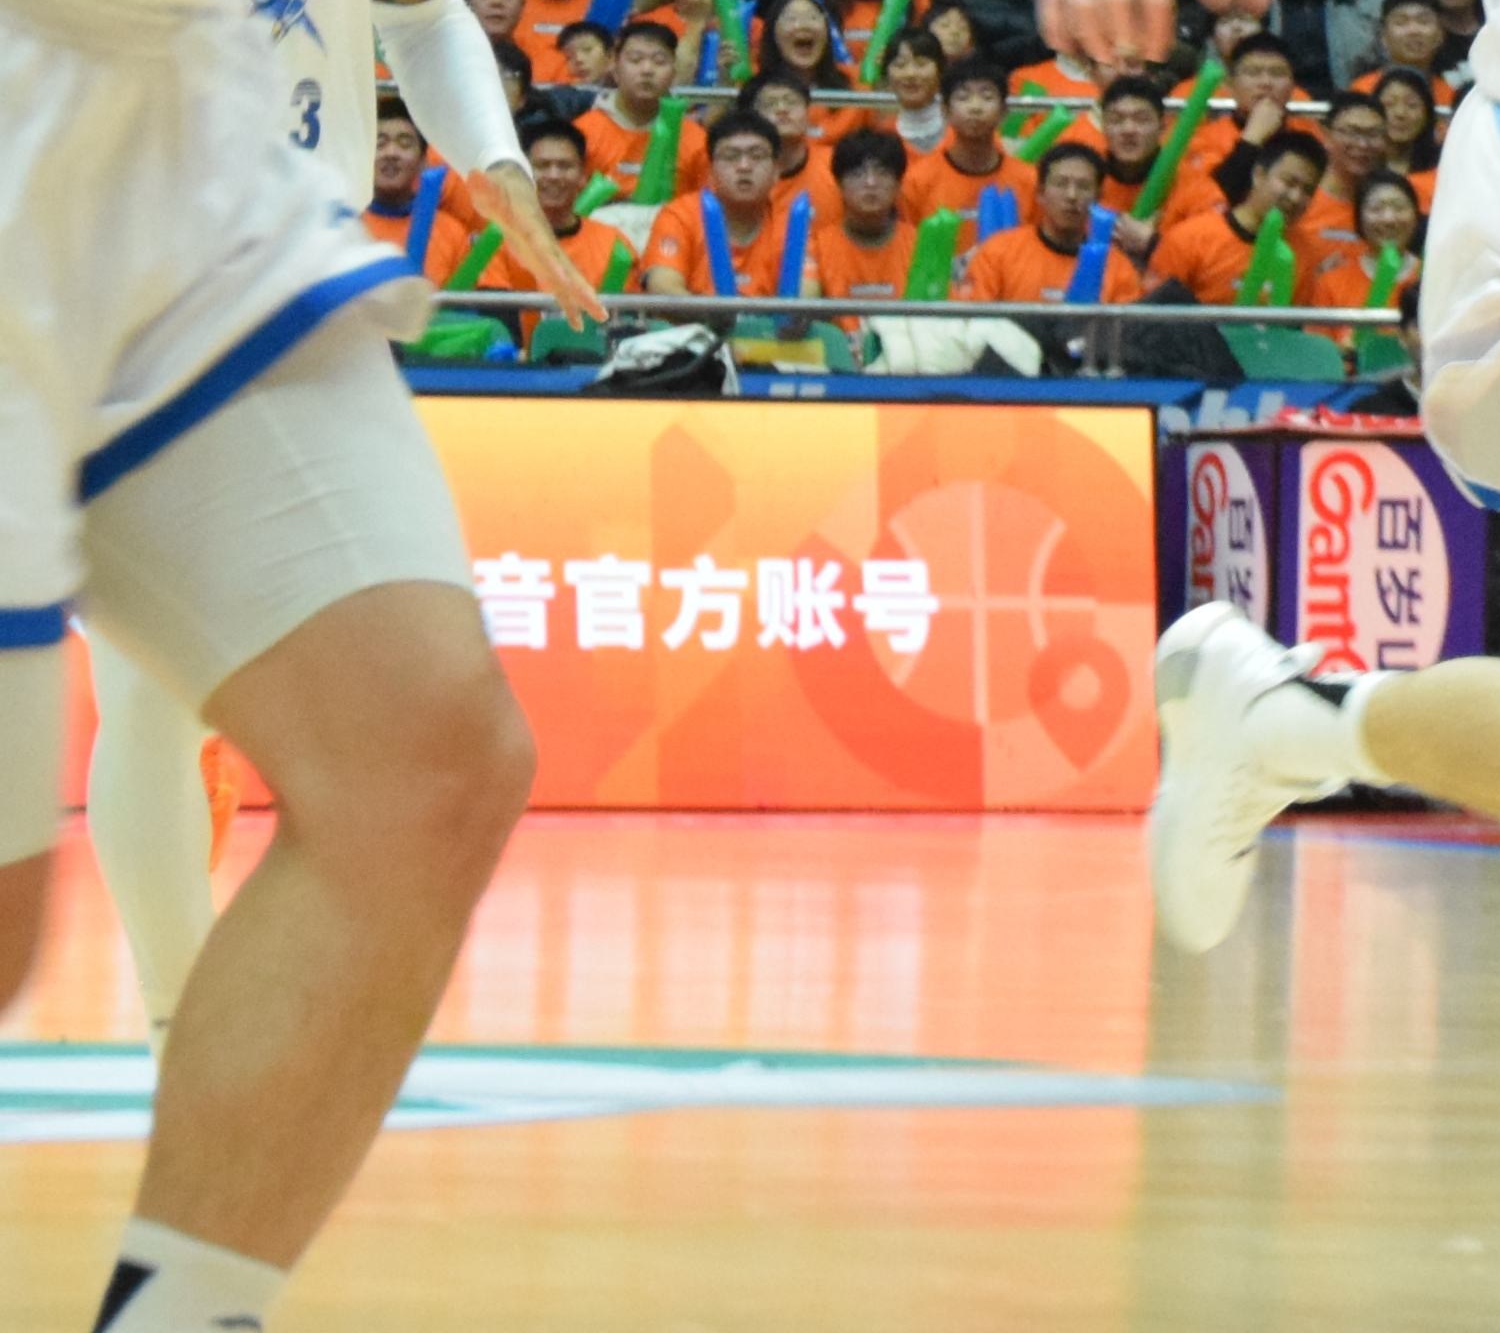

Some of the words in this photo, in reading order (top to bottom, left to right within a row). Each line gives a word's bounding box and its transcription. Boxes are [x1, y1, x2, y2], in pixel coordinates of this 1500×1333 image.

[470, 551, 940, 654] 音官方账号
